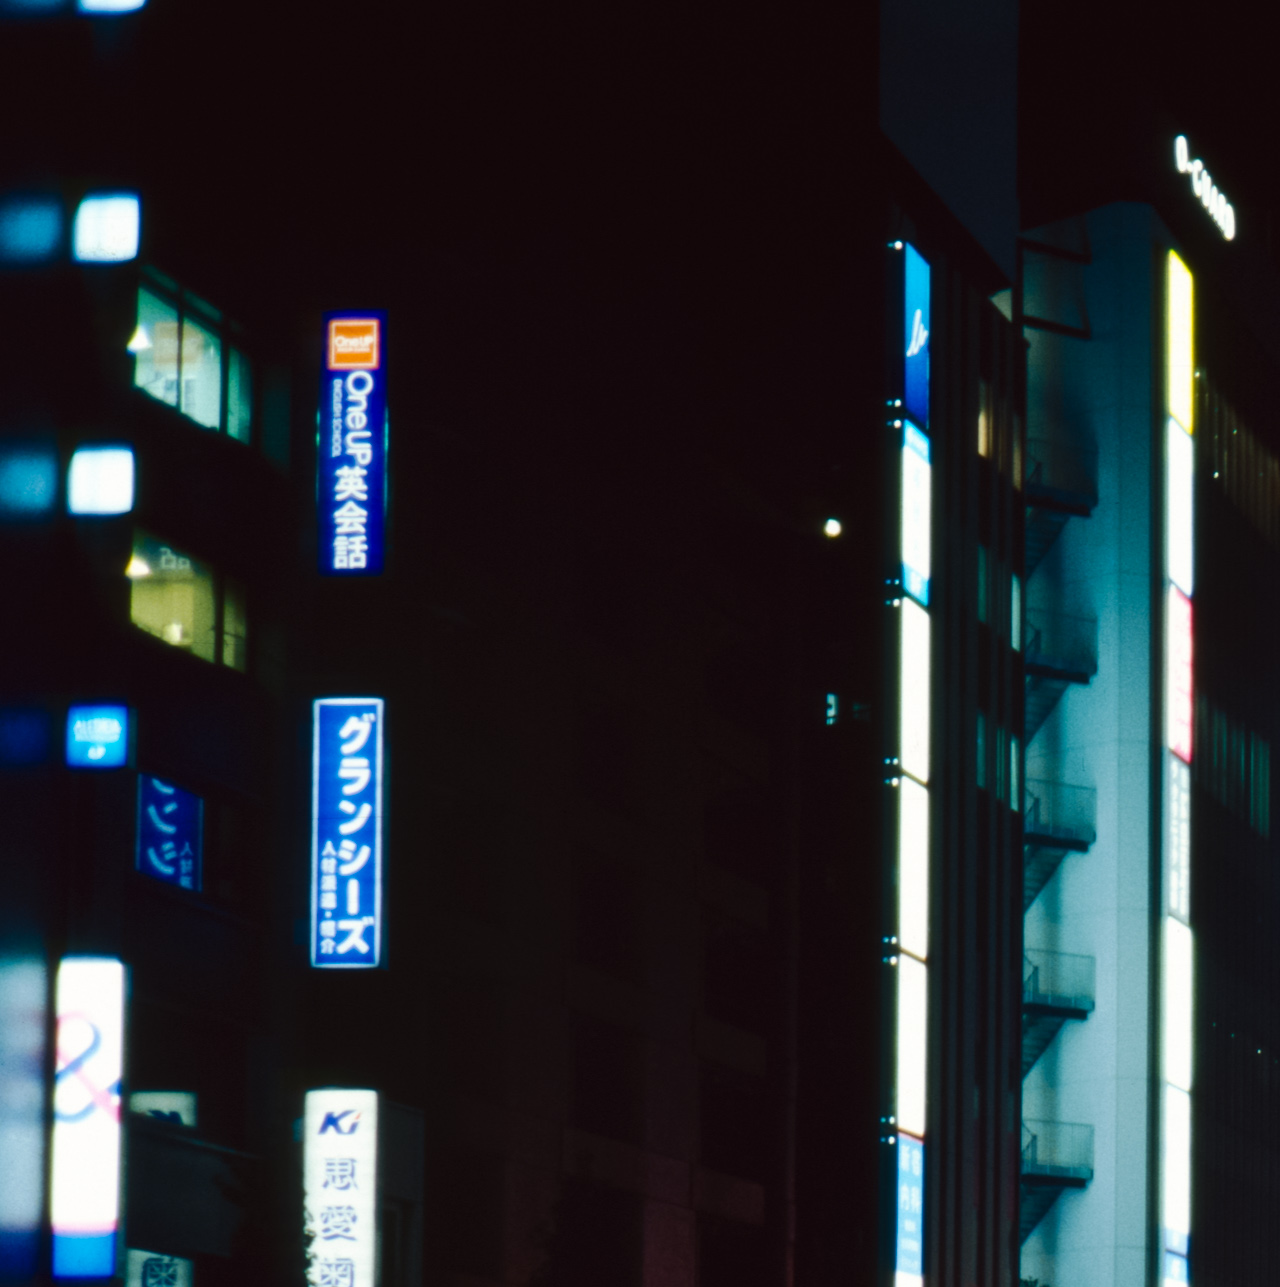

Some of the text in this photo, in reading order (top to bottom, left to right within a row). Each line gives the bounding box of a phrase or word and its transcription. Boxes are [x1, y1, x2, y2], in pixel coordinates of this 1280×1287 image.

[334, 335, 375, 348] OneUP
[333, 466, 369, 570] 英会話
[337, 712, 376, 955] グランシーズ
